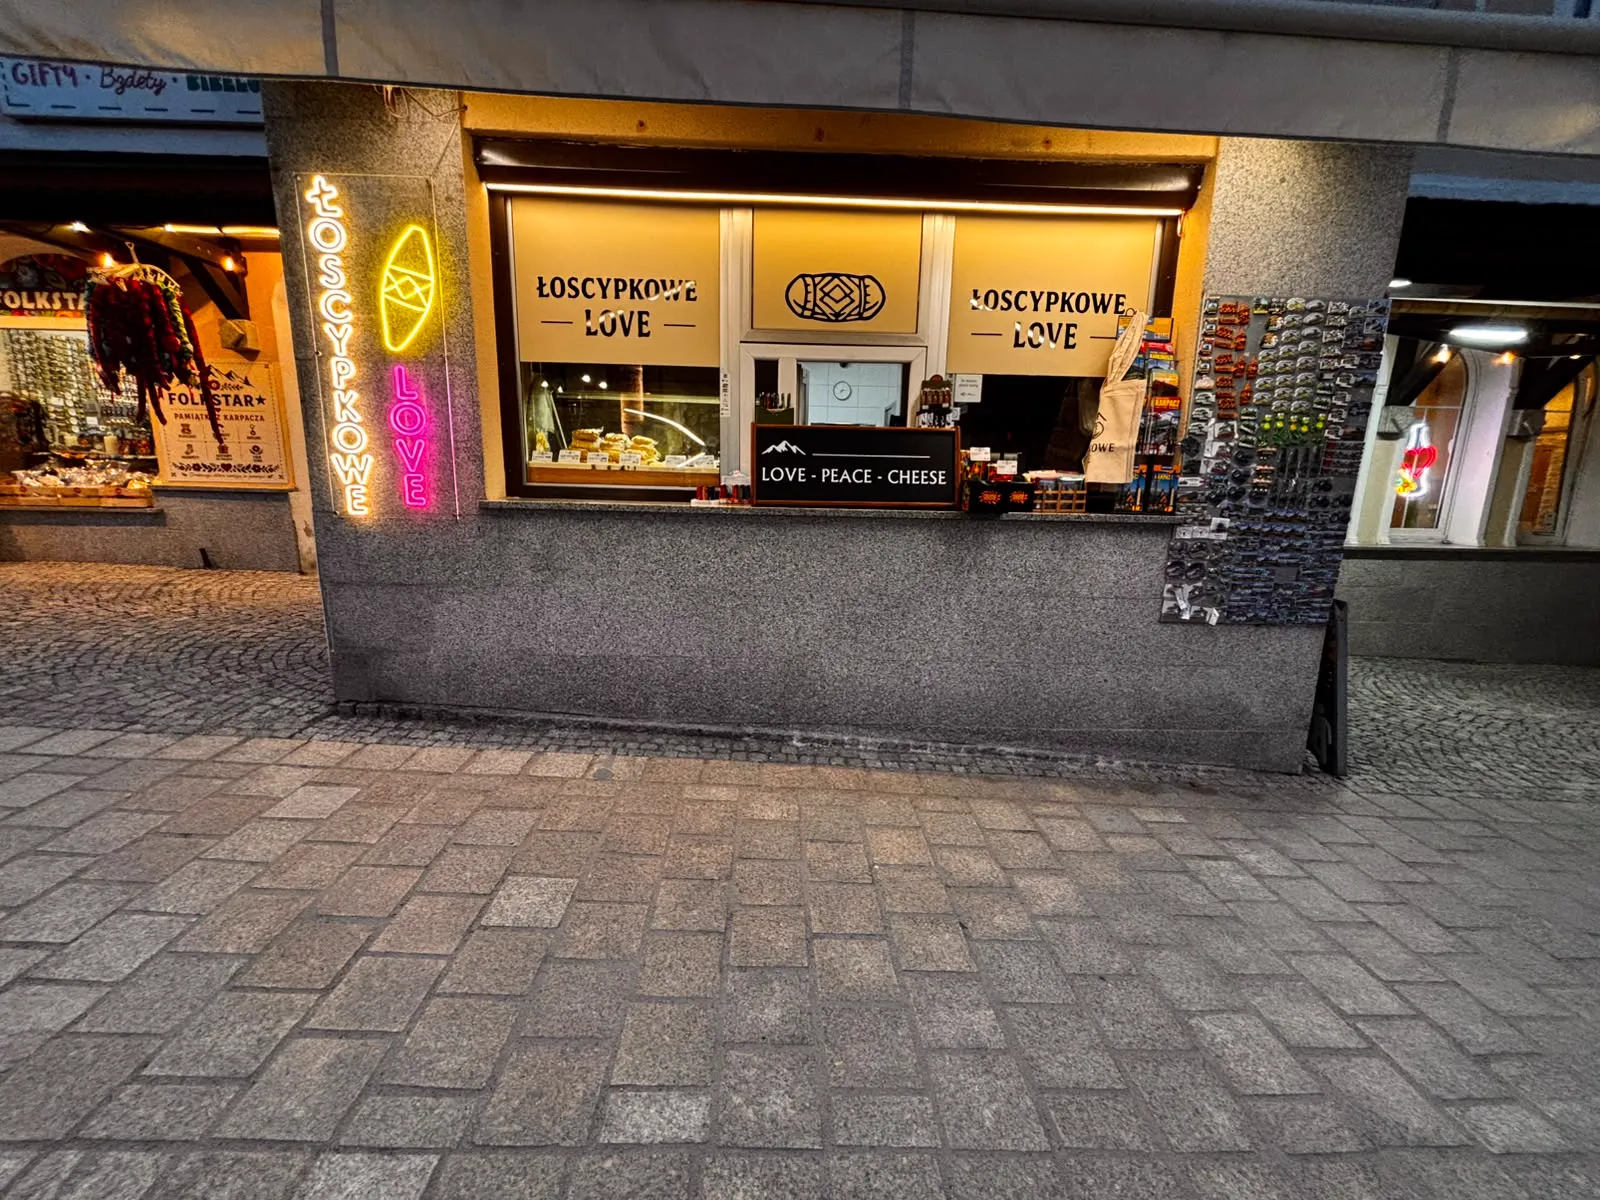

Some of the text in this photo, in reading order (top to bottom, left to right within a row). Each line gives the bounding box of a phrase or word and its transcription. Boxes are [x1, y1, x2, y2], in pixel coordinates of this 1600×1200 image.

[100, 67, 167, 96] Bzdety
[536, 276, 698, 301] ŁOSCYPKOWE
[970, 289, 1127, 315] ŁOSCYPKOWE
[584, 309, 651, 337] LOVE
[1013, 321, 1078, 350] LOVE
[168, 393, 254, 407] FOLSTAR
[389, 364, 427, 507] LOVE
[761, 466, 807, 482] LOVE
[821, 468, 872, 484] PEACE
[887, 470, 947, 485] CHEESE
